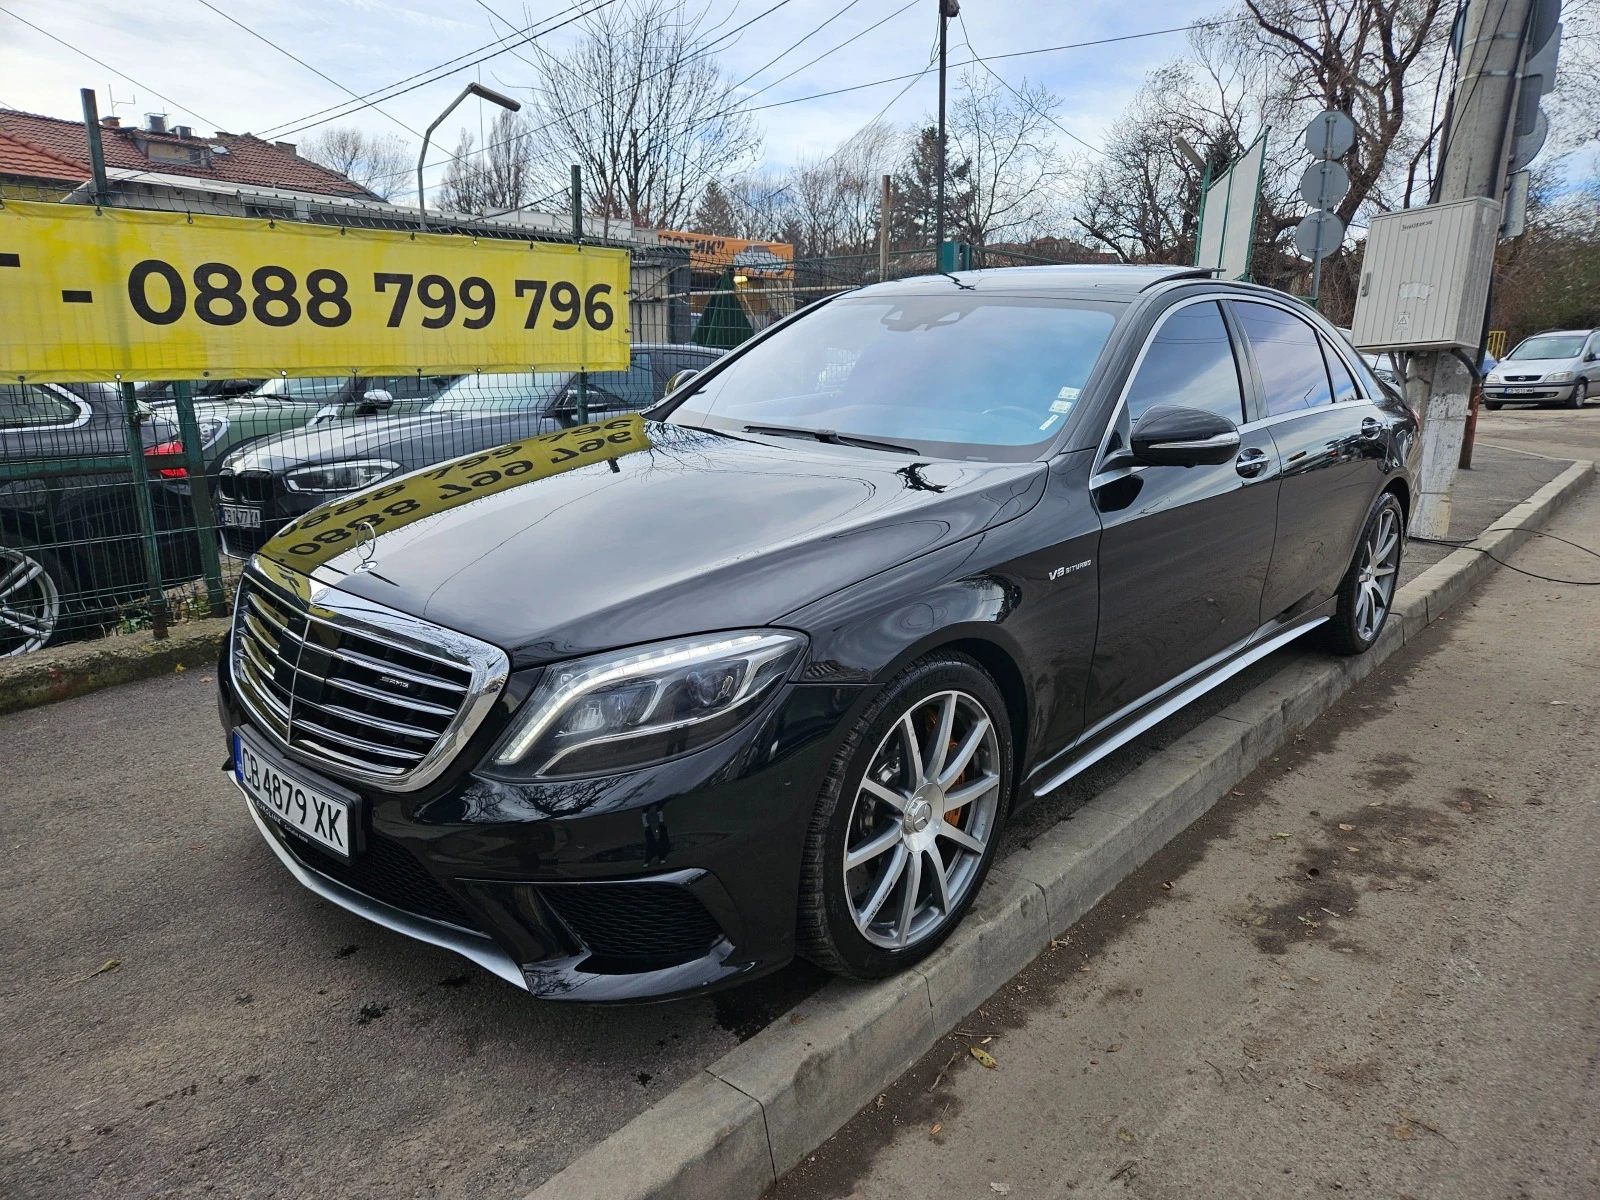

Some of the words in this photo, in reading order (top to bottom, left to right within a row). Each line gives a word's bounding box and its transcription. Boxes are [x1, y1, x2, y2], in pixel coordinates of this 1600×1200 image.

[128, 259, 352, 327] 0888
[374, 272, 496, 330] 799
[514, 279, 615, 332] 796
[1048, 566, 1065, 581] V8
[1065, 559, 1092, 574] BITURBO
[242, 747, 261, 792] CB
[263, 767, 307, 825] 4879
[312, 795, 344, 848] XK
